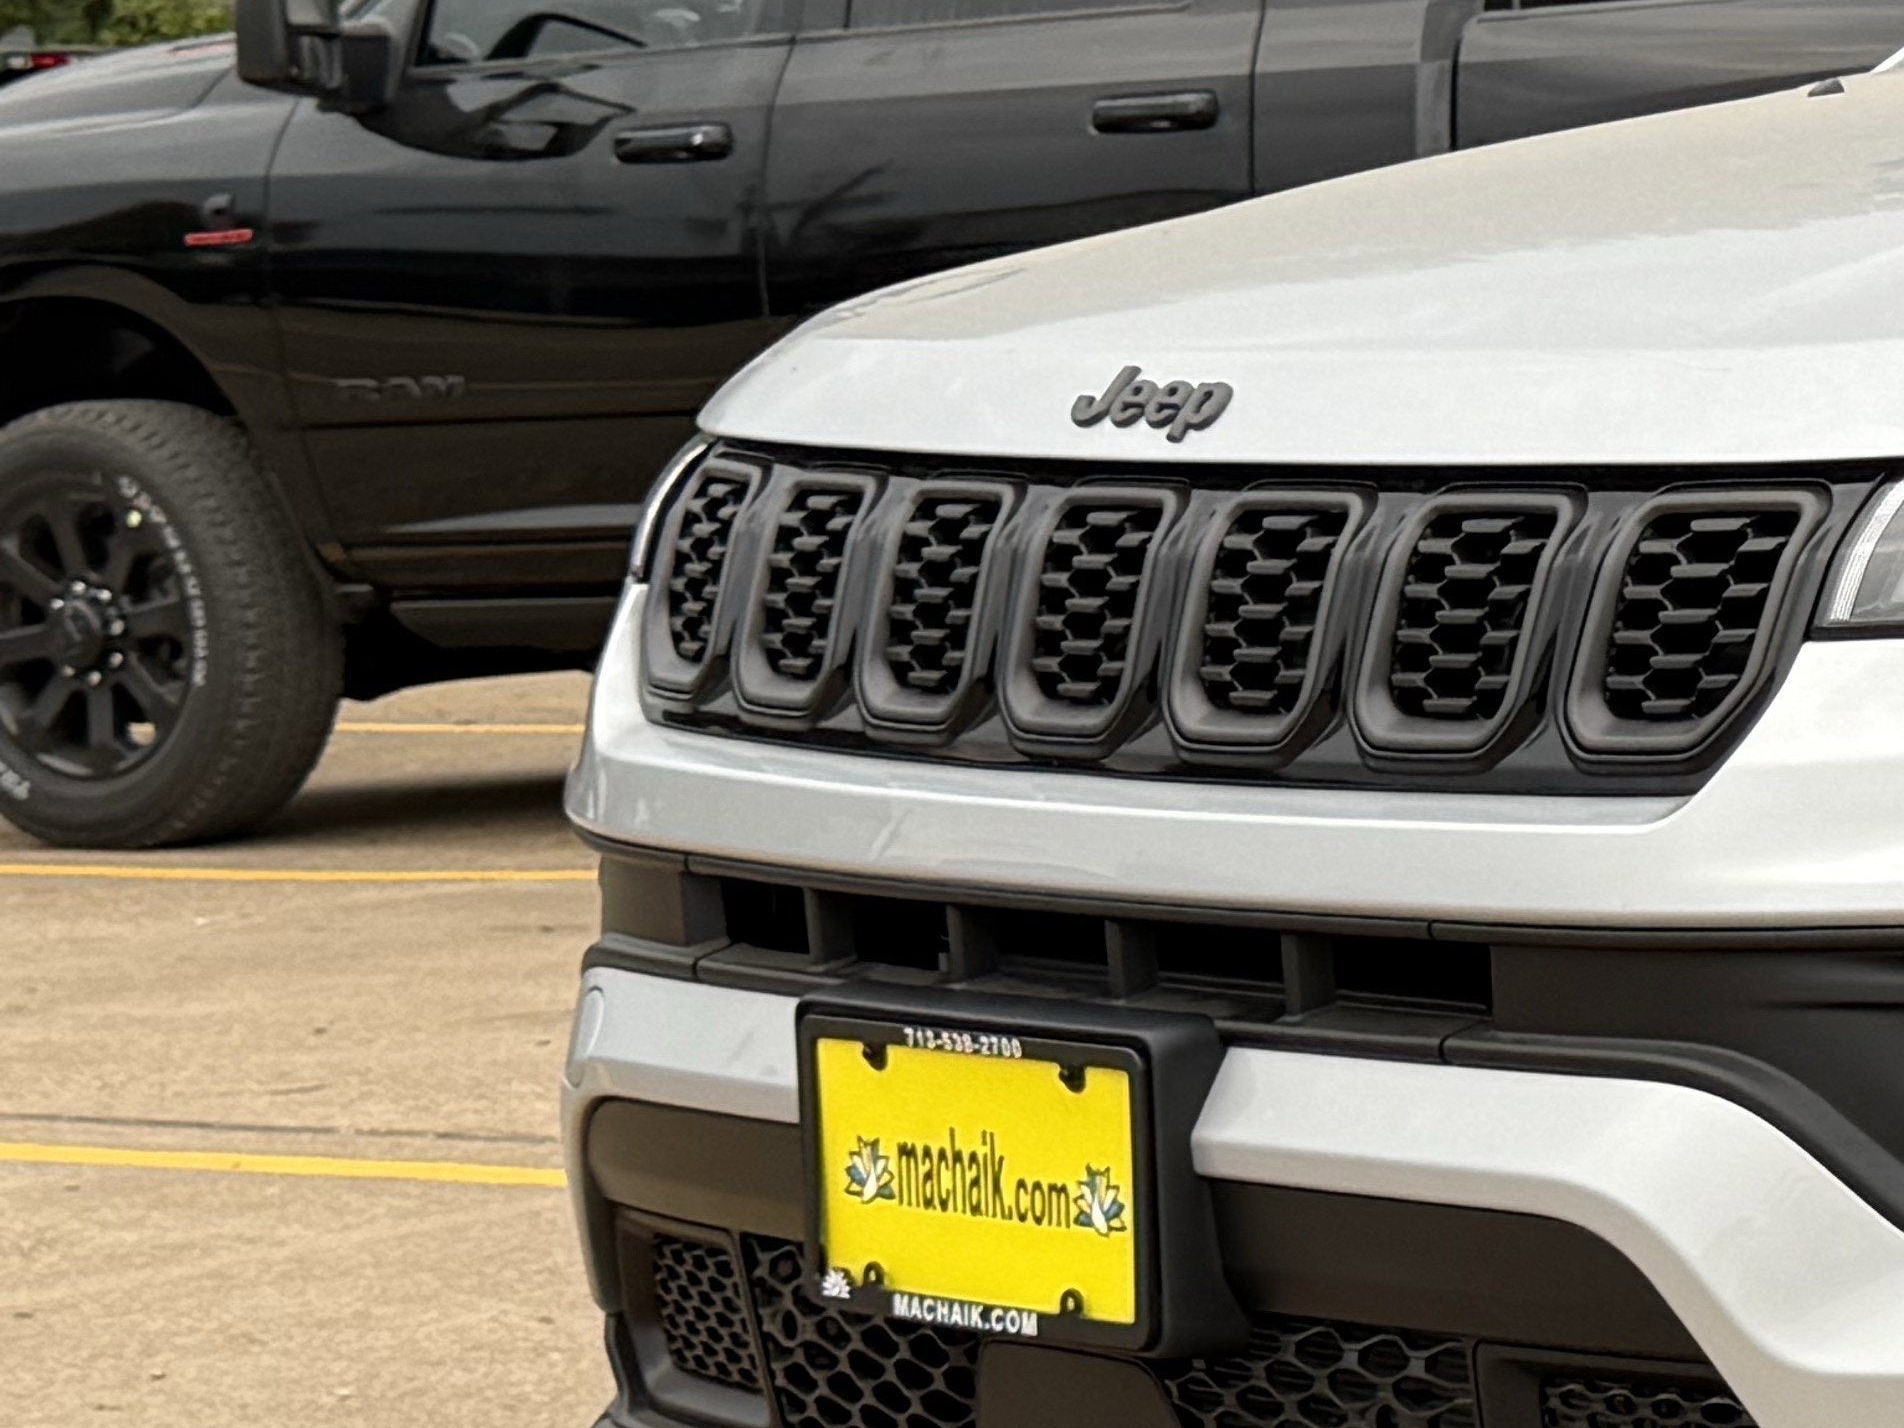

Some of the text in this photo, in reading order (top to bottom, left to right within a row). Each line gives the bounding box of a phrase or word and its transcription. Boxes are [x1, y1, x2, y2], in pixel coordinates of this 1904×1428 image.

[1071, 365, 1234, 443] Jeep
[897, 1126, 1071, 1229] machaik.com
[892, 1292, 1038, 1336] MACHAIK.COM
